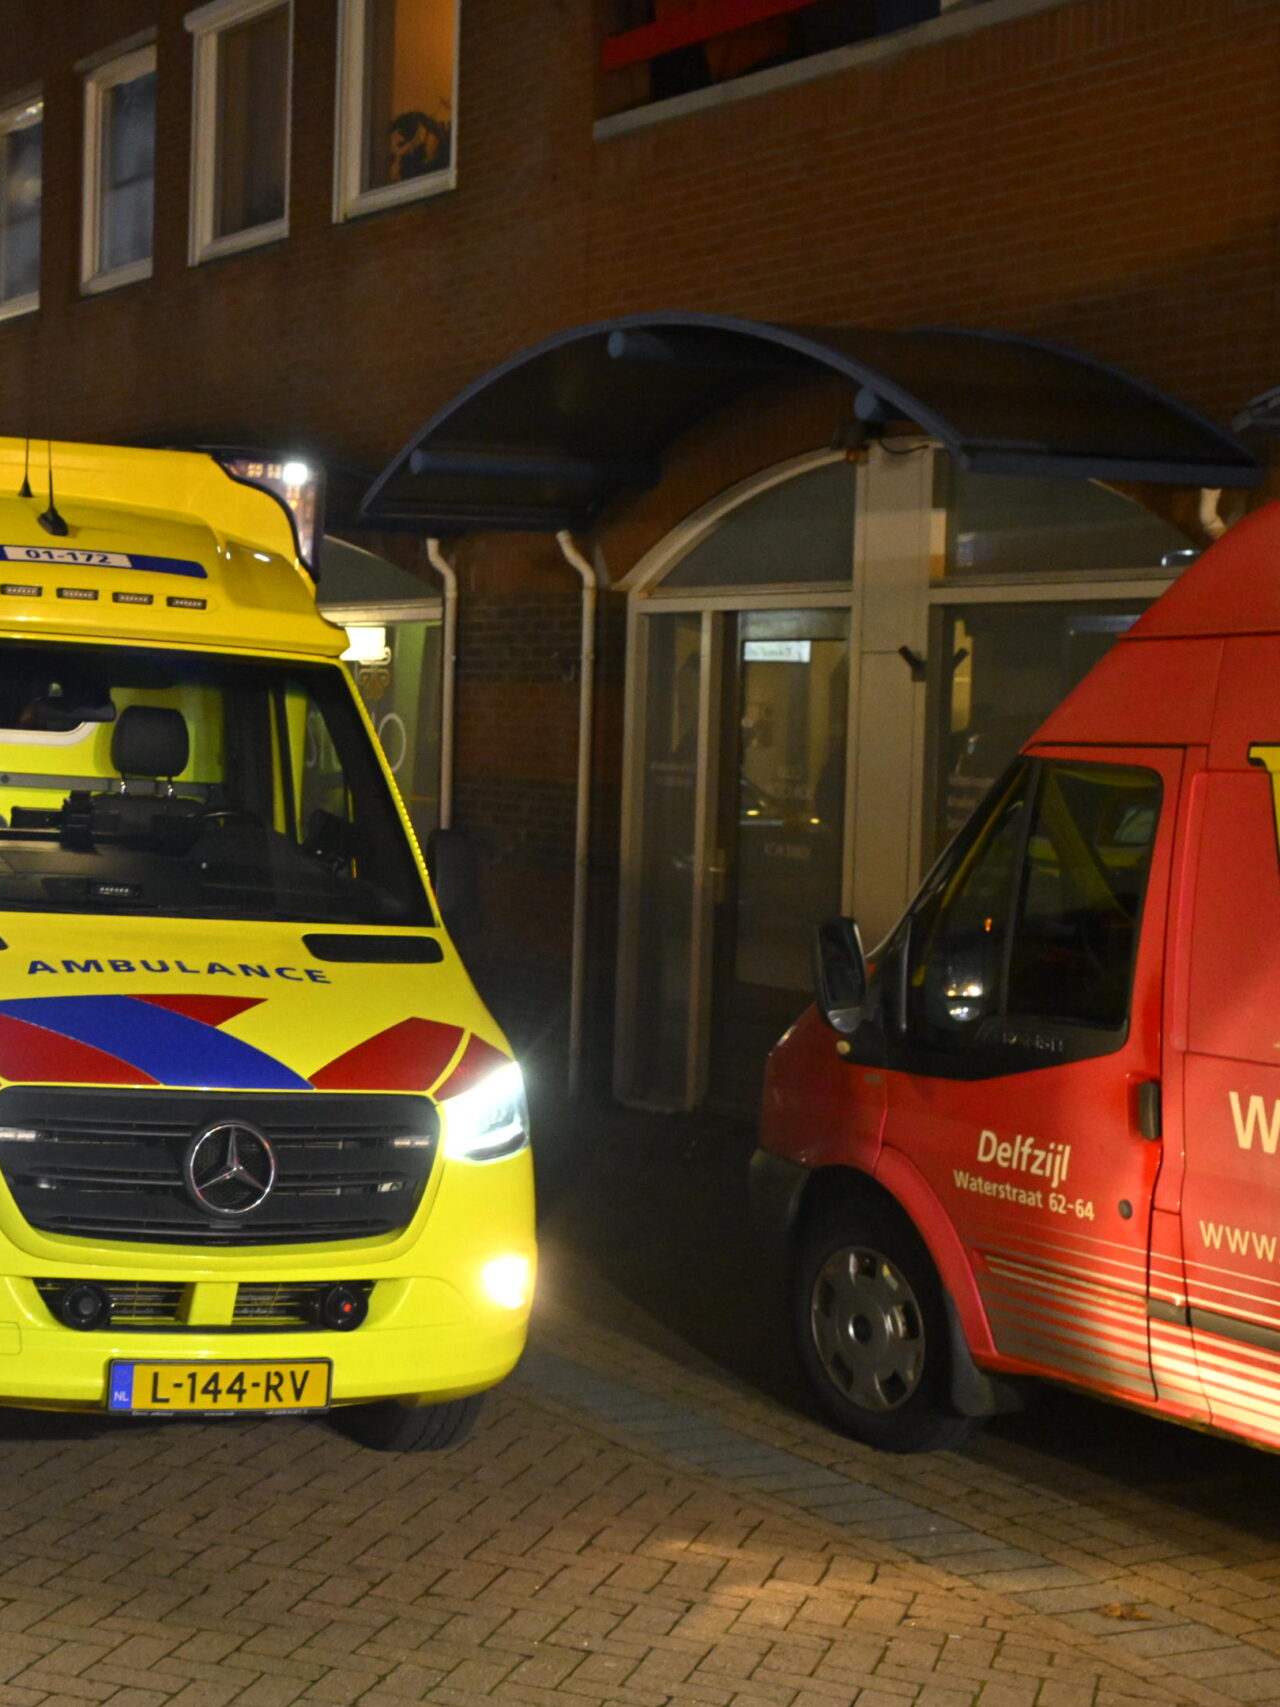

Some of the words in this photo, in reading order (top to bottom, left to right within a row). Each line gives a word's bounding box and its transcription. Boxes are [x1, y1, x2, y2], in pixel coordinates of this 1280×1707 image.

[25, 549, 112, 564] 01-172
[27, 959, 332, 984] AMBULANCE
[977, 1130, 1071, 1188] Delfzijl
[953, 1168, 1044, 1208] Waterstraat
[1049, 1192, 1095, 1221] 62-64
[114, 1391, 129, 1402] NL
[151, 1370, 310, 1403] L-144-RV
